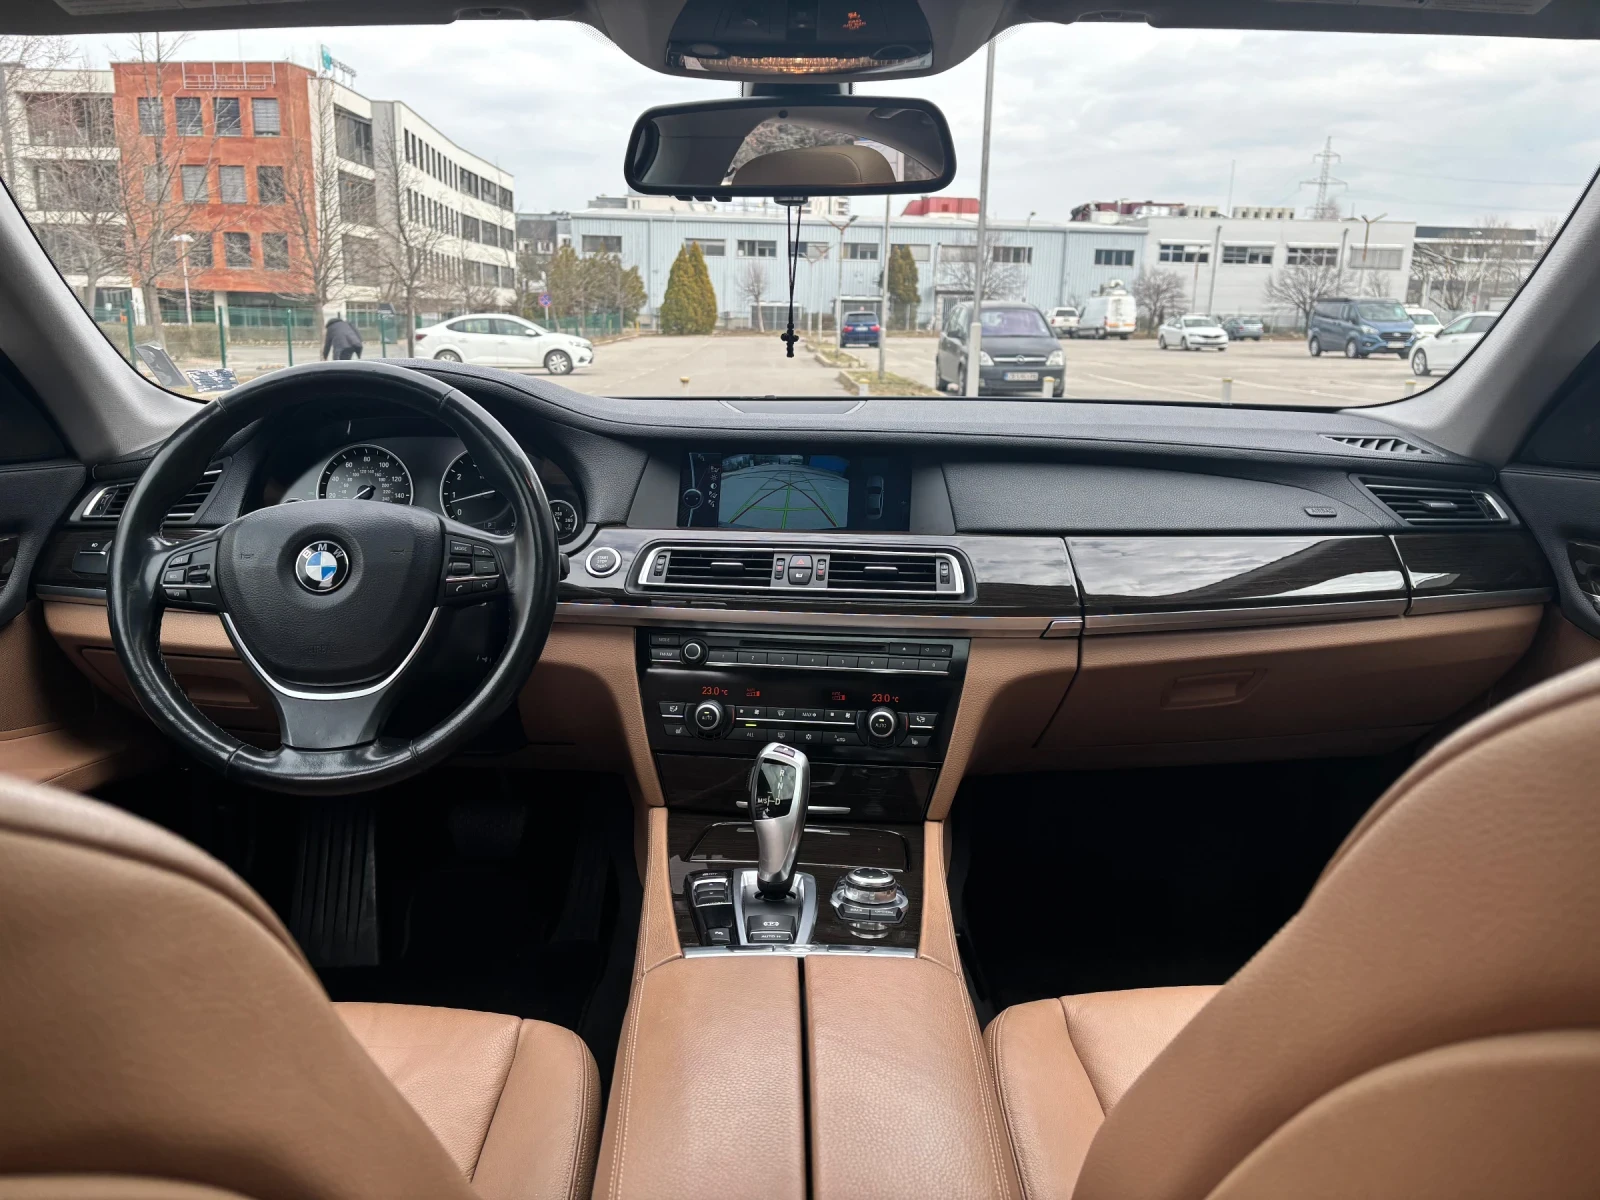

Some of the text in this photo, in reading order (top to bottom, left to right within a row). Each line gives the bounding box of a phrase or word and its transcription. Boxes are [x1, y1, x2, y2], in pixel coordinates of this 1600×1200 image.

[457, 508, 462, 516] 0
[302, 543, 343, 559] BMW
[702, 686, 720, 696] 23.0
[871, 693, 891, 702] 23.0
[780, 769, 785, 777] R
[777, 782, 784, 790] N
[774, 797, 780, 806] D
